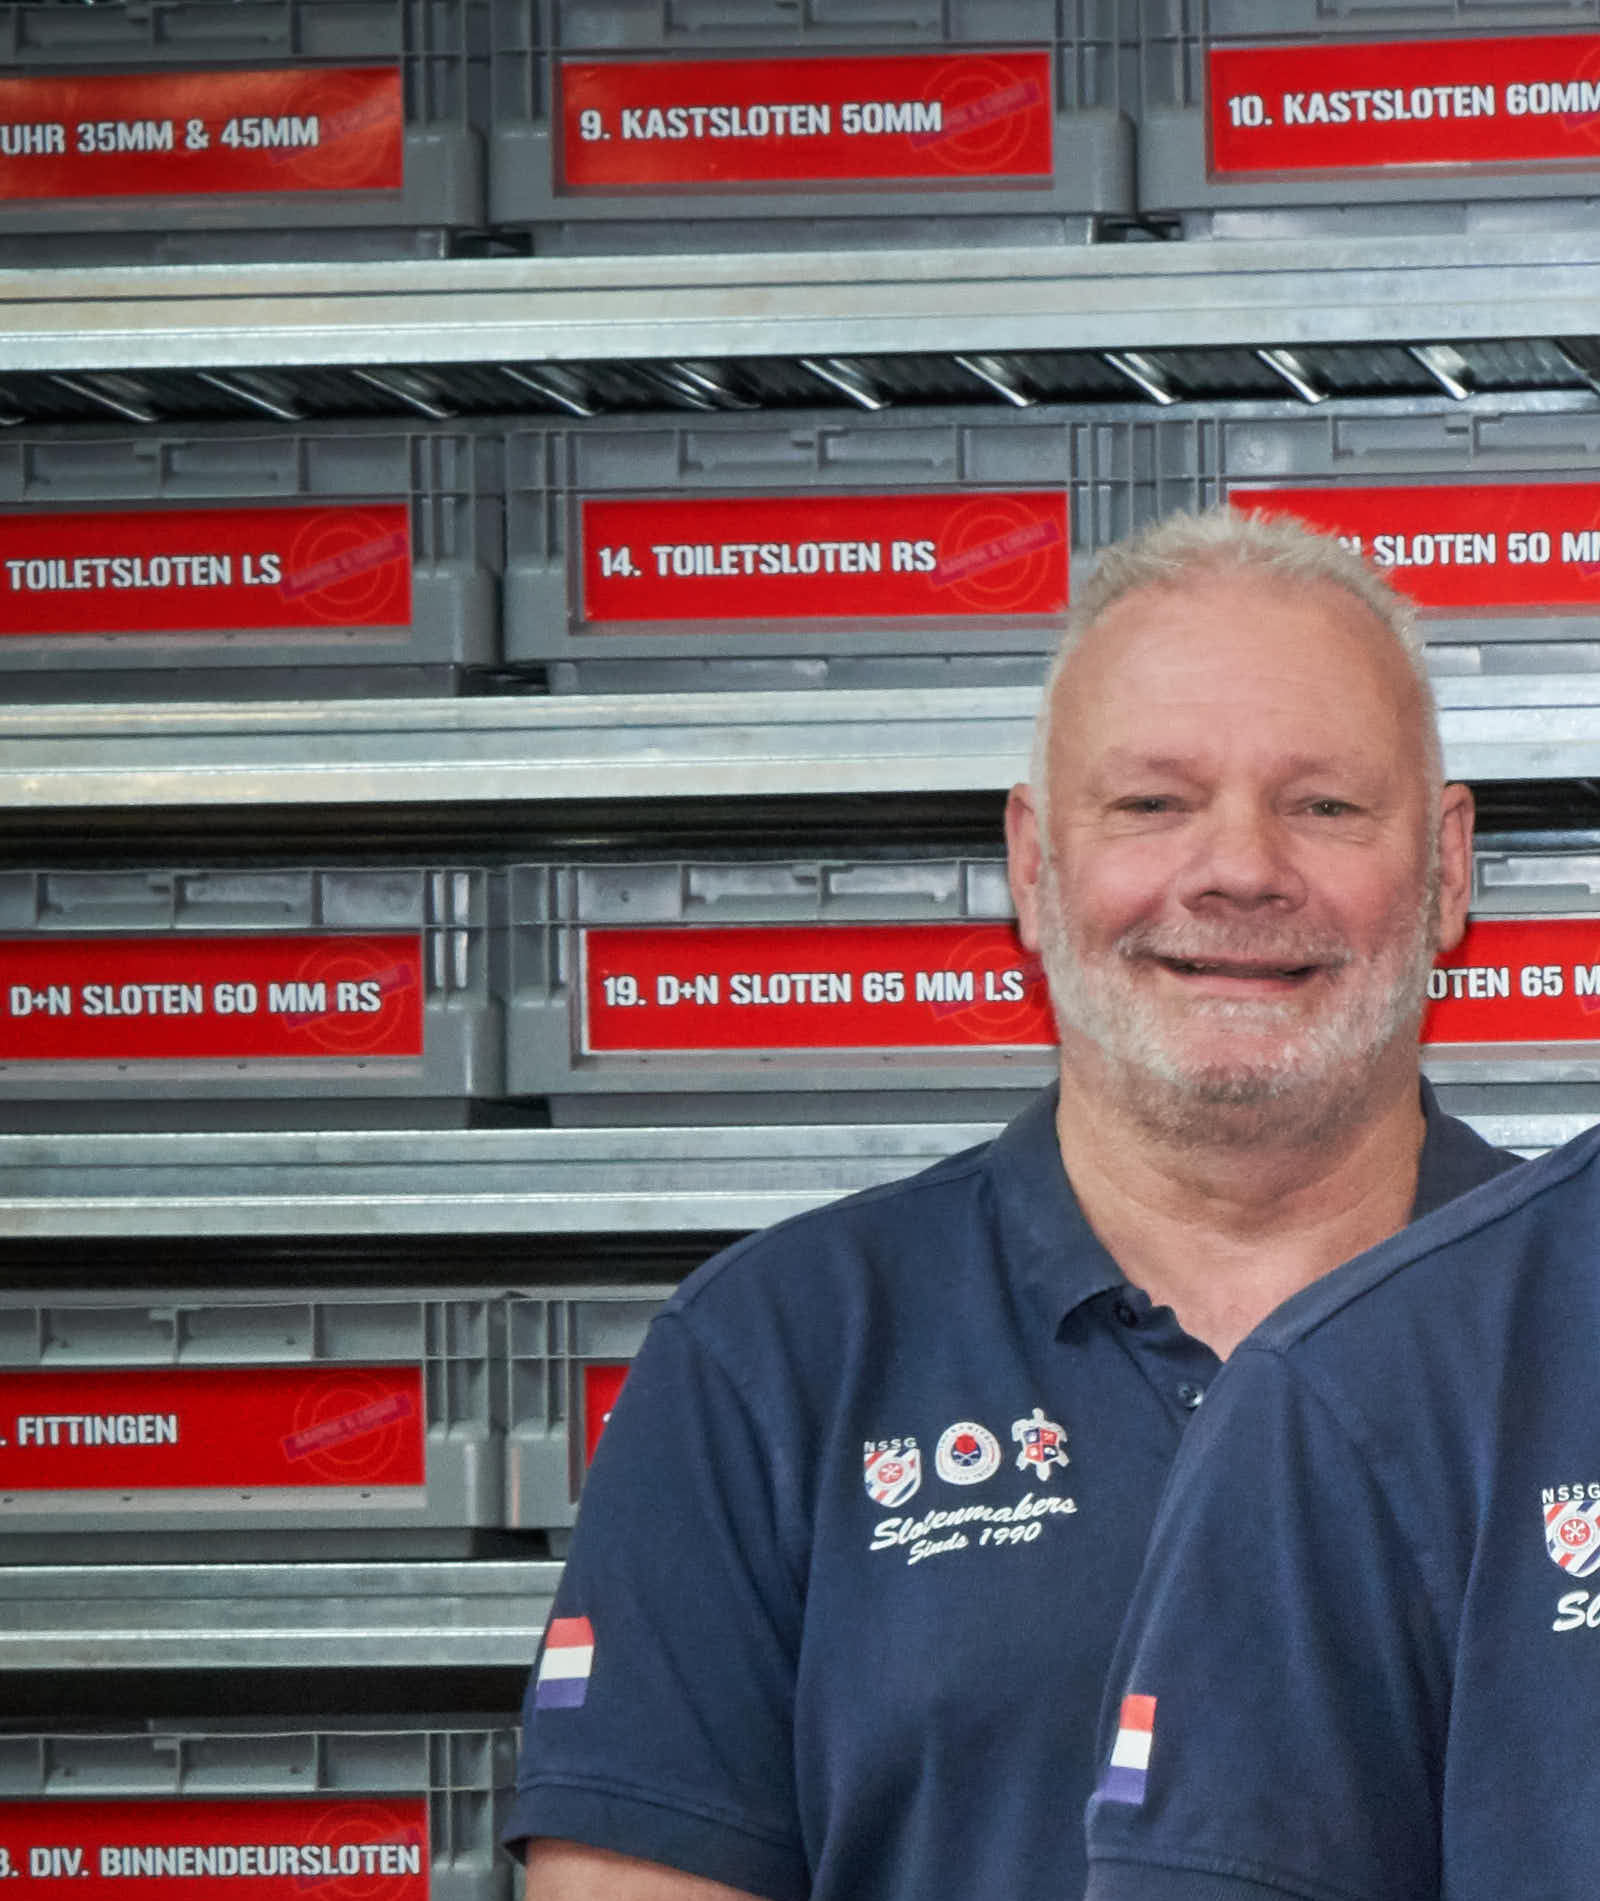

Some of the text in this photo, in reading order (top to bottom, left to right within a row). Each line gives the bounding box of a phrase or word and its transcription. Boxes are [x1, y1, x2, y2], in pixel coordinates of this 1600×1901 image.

[579, 108, 612, 142] 9.
[620, 103, 832, 141] KASTSLOTEN
[840, 100, 944, 136] 50MM
[1227, 94, 1274, 128] 10.
[1282, 83, 1497, 127] KASTSLOTEN
[75, 118, 175, 154] 35MM
[184, 117, 211, 151] &
[219, 114, 322, 150] 45MM
[597, 545, 643, 578] 14.
[650, 540, 882, 578] TOILETSLOTEN
[890, 539, 938, 573] RS
[1372, 532, 1498, 568] SLOTEN
[1506, 530, 1552, 565] 50
[4, 554, 233, 592] TOILETSLOTEN
[241, 552, 284, 586] LS
[9, 984, 73, 1017] D+N
[80, 982, 205, 1017] SLOTEN
[212, 982, 259, 1015] 60
[266, 981, 328, 1014] MM
[335, 980, 383, 1014] RS
[602, 969, 1026, 1008] 19. D+N SLOTEN 65 MM LS
[1519, 964, 1565, 999] 65
[16, 1413, 179, 1447] FITTINGEN
[863, 1436, 917, 1453] NSSG
[869, 1492, 1079, 1551] Slotenmakers
[906, 1521, 1043, 1566] Sinds 1990
[28, 1846, 90, 1878] DIV.
[99, 1843, 422, 1878] BINNENDEURSLOTEN
